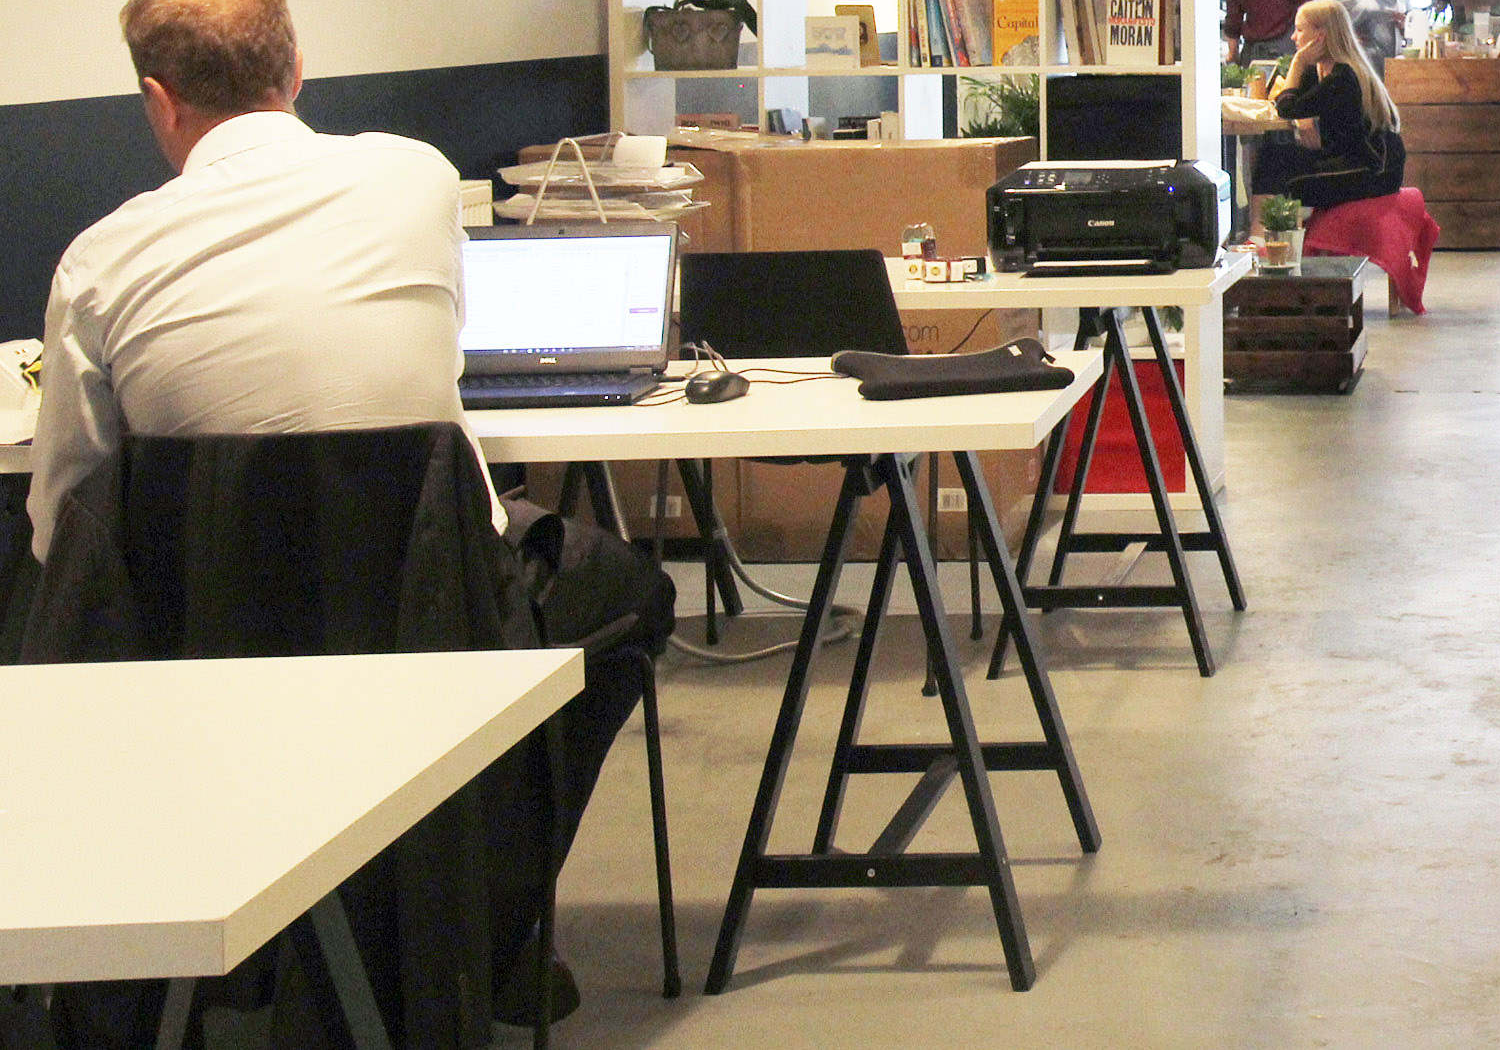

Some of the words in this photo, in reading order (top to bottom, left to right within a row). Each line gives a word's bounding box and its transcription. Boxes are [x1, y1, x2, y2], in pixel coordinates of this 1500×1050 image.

[997, 15, 1039, 32] Capital
[1110, 25, 1153, 46] MORAN
[1087, 219, 1115, 227] Canon
[903, 325, 940, 342] om
